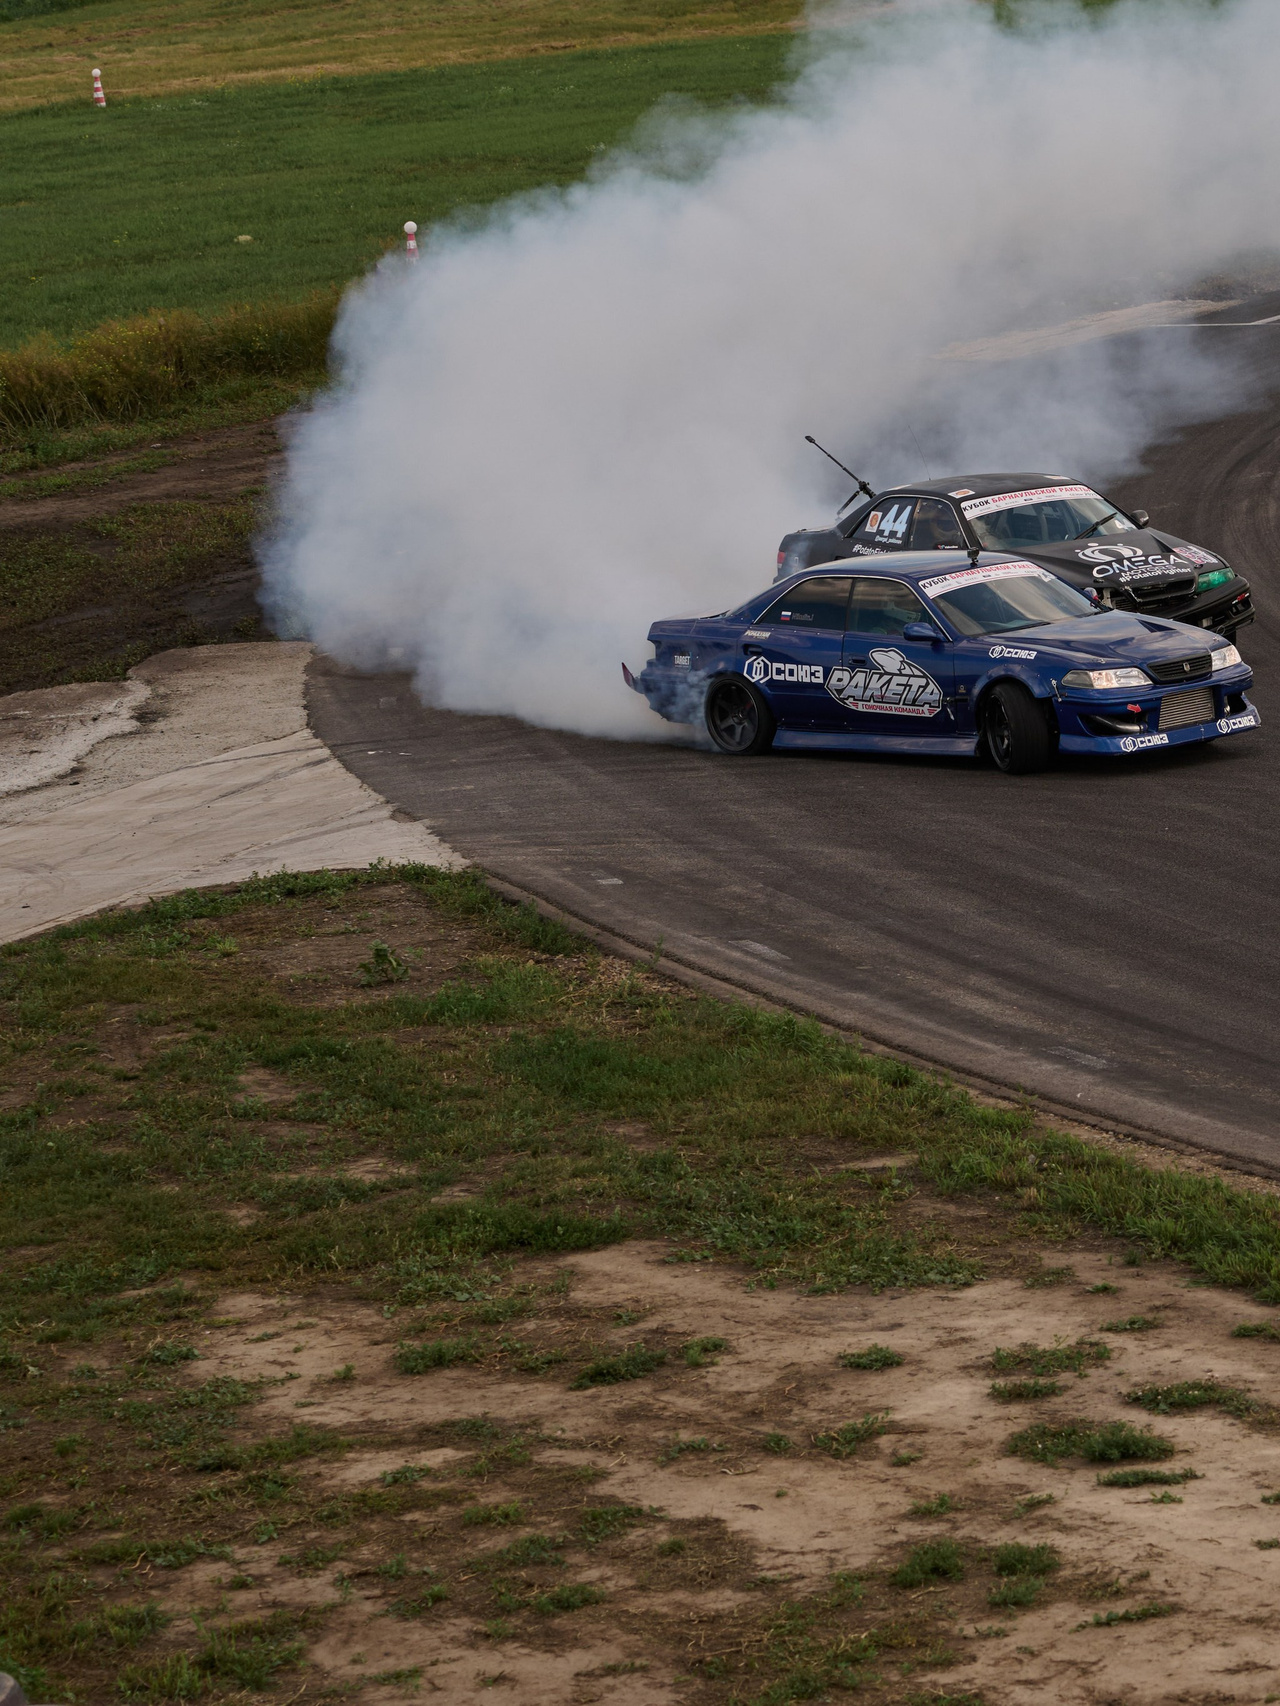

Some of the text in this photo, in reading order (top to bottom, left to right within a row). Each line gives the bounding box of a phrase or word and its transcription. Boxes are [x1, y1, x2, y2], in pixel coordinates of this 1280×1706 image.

[962, 499, 991, 512] КУБОК
[991, 488, 1057, 503] БАРНАУЛЬСКОЙ
[879, 504, 912, 538] 44
[1092, 554, 1188, 578] OMEGA
[1121, 564, 1177, 578] MOTORS
[920, 575, 950, 590] КУБОК
[948, 564, 1011, 580] БАРНАУЛЬСКОЙ
[1119, 567, 1192, 583] #PotatoFighter
[674, 655, 691, 666] TARGET
[1003, 648, 1037, 660] СОЮЗ
[772, 662, 824, 684] СОЮЗ
[827, 668, 940, 707] РАКЕТА
[861, 703, 926, 715] ГОНОЧНАЯ КОМАНДА
[1231, 716, 1256, 729] СОЮЗ
[1137, 733, 1169, 748] СОЮЗ
